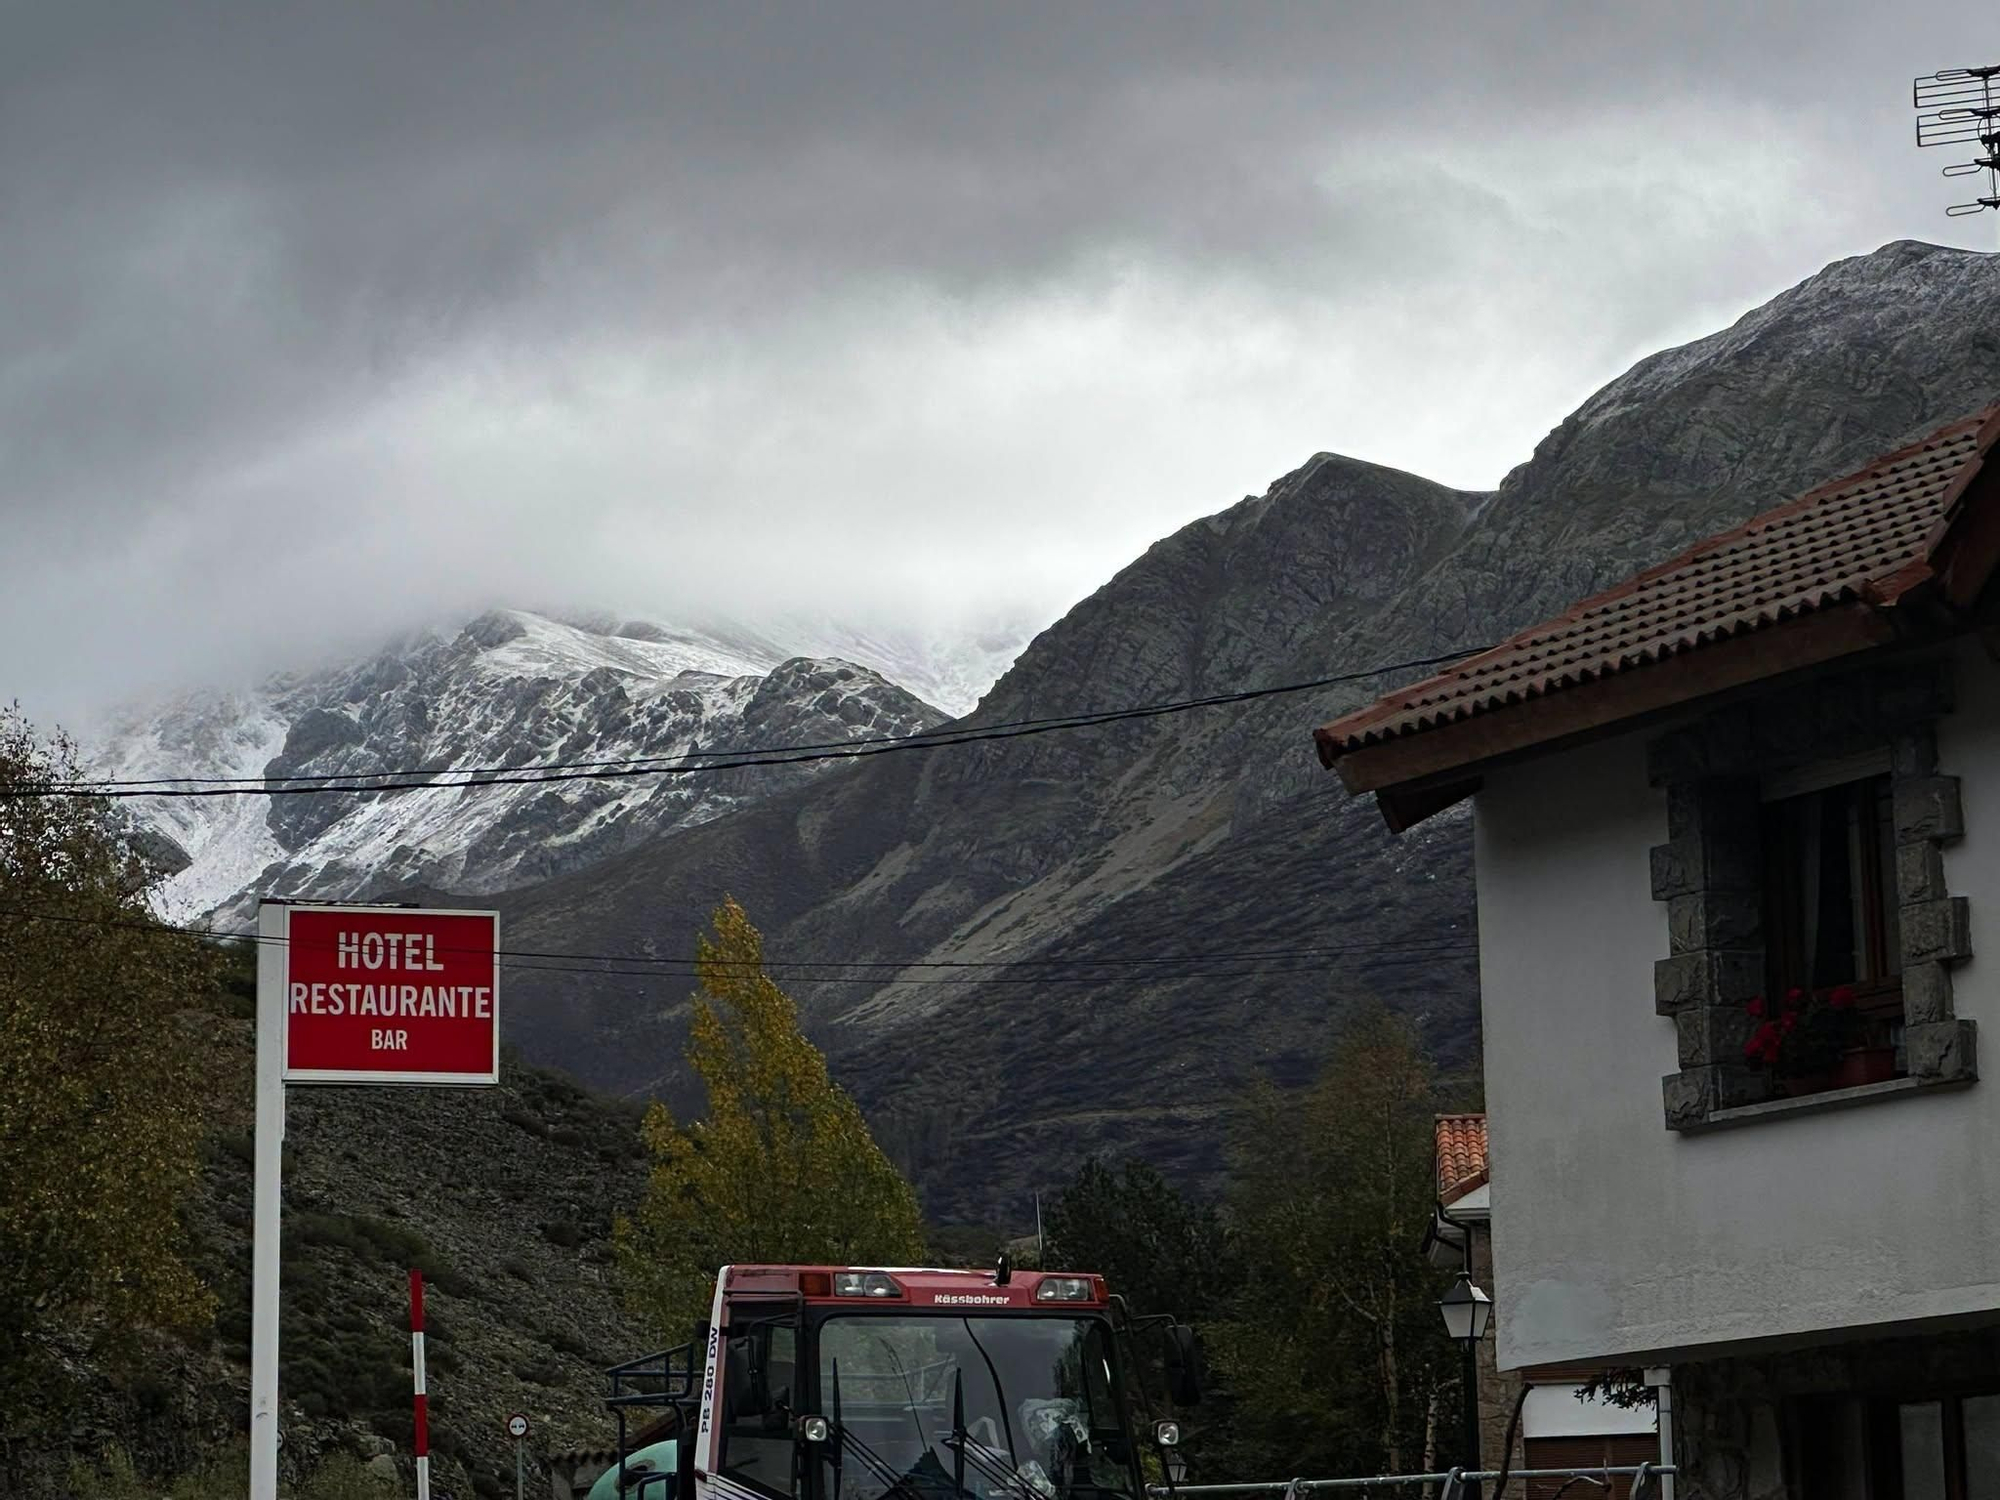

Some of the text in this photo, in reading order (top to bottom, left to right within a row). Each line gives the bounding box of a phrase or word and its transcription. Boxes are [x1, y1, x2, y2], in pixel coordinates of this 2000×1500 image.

[338, 931, 444, 971] HOTEL
[290, 982, 491, 1018] RESTAURANTE
[371, 1029, 408, 1050] BAR
[934, 1294, 1010, 1304] Kässbohrer
[701, 1327, 718, 1433] PB 280 DW
